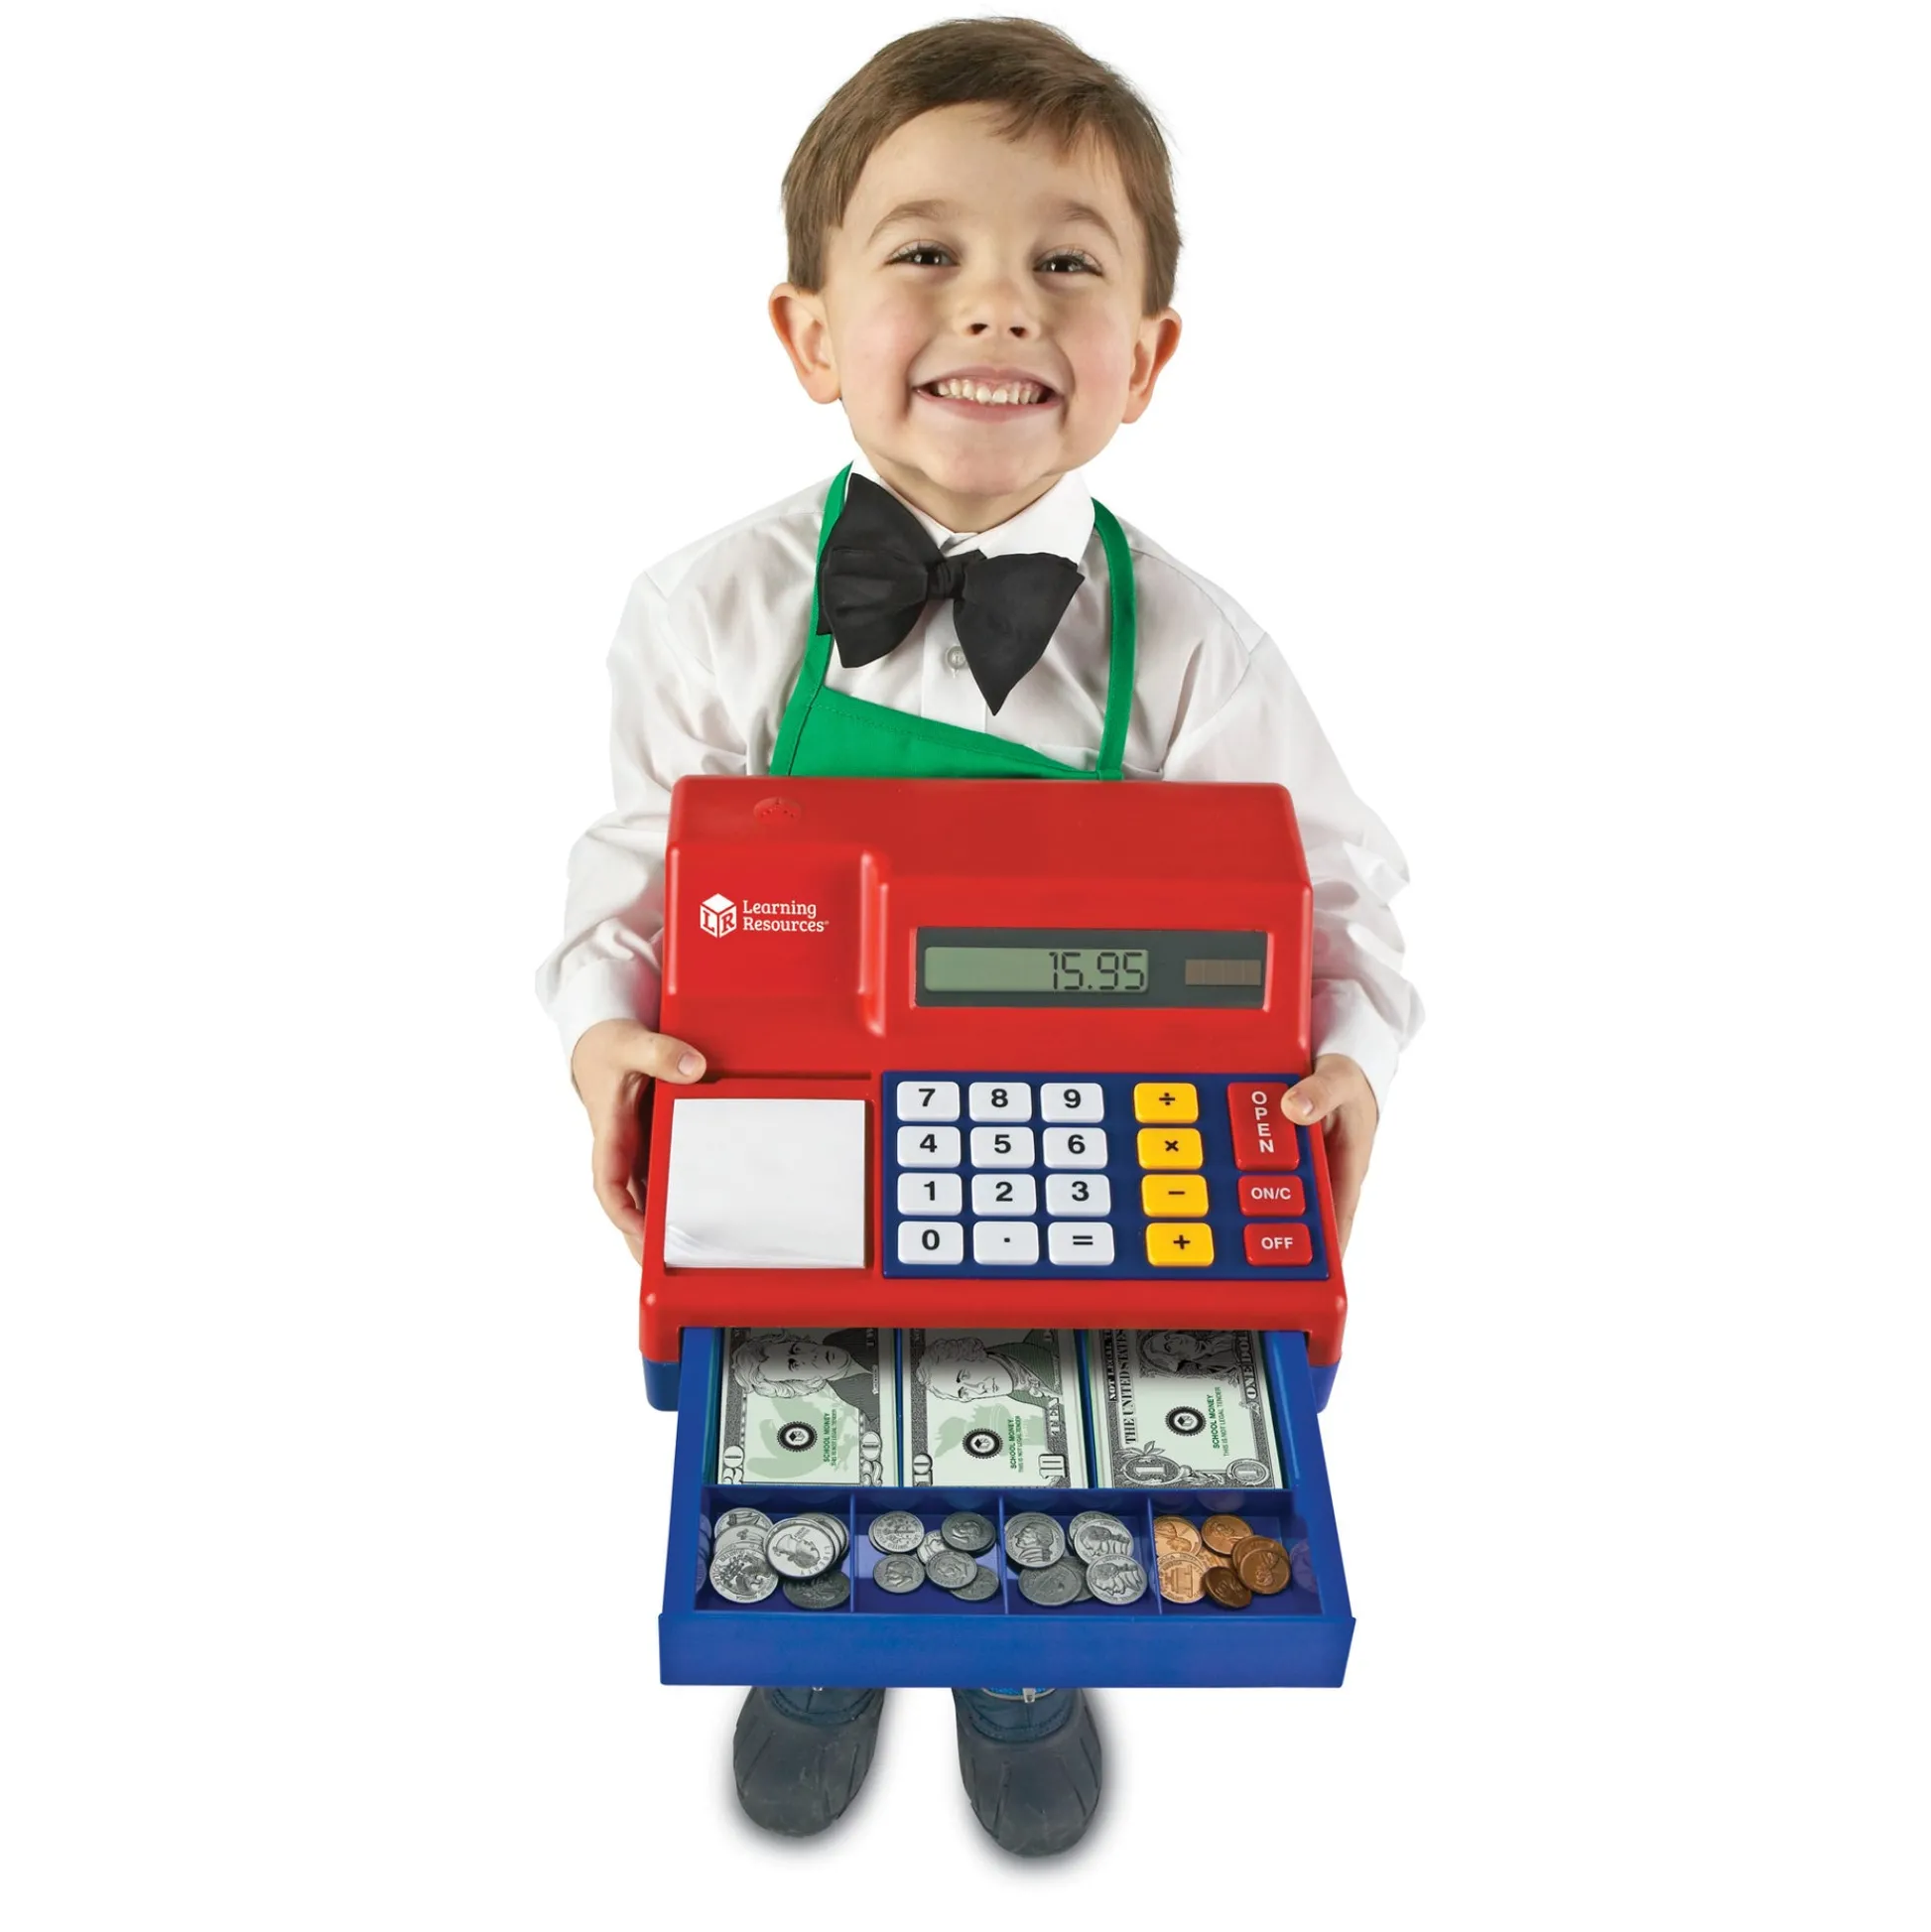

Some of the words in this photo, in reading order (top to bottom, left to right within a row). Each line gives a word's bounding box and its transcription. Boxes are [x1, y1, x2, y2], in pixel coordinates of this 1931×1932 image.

[742, 900, 817, 919] Learning
[742, 917, 826, 932] Resources
[1048, 952, 1144, 990] 15.95
[918, 1088, 936, 1107] 7
[990, 1088, 1008, 1108] 8
[1063, 1089, 1082, 1108] 9
[1251, 1091, 1275, 1153] OPEN
[919, 1133, 938, 1153] 4
[993, 1134, 1012, 1154] 5
[1067, 1134, 1086, 1154] 6
[923, 1181, 936, 1201] 1
[995, 1181, 1013, 1202] 2
[1071, 1181, 1090, 1202] 3
[1250, 1187, 1291, 1200] ON/C
[921, 1228, 940, 1250] 0
[1260, 1236, 1293, 1250] OFF
[1120, 1370, 1134, 1415] UNITED
[1242, 1365, 1258, 1400] ONE
[1125, 1419, 1137, 1445] THE
[1211, 1420, 1220, 1449] SCHOOL
